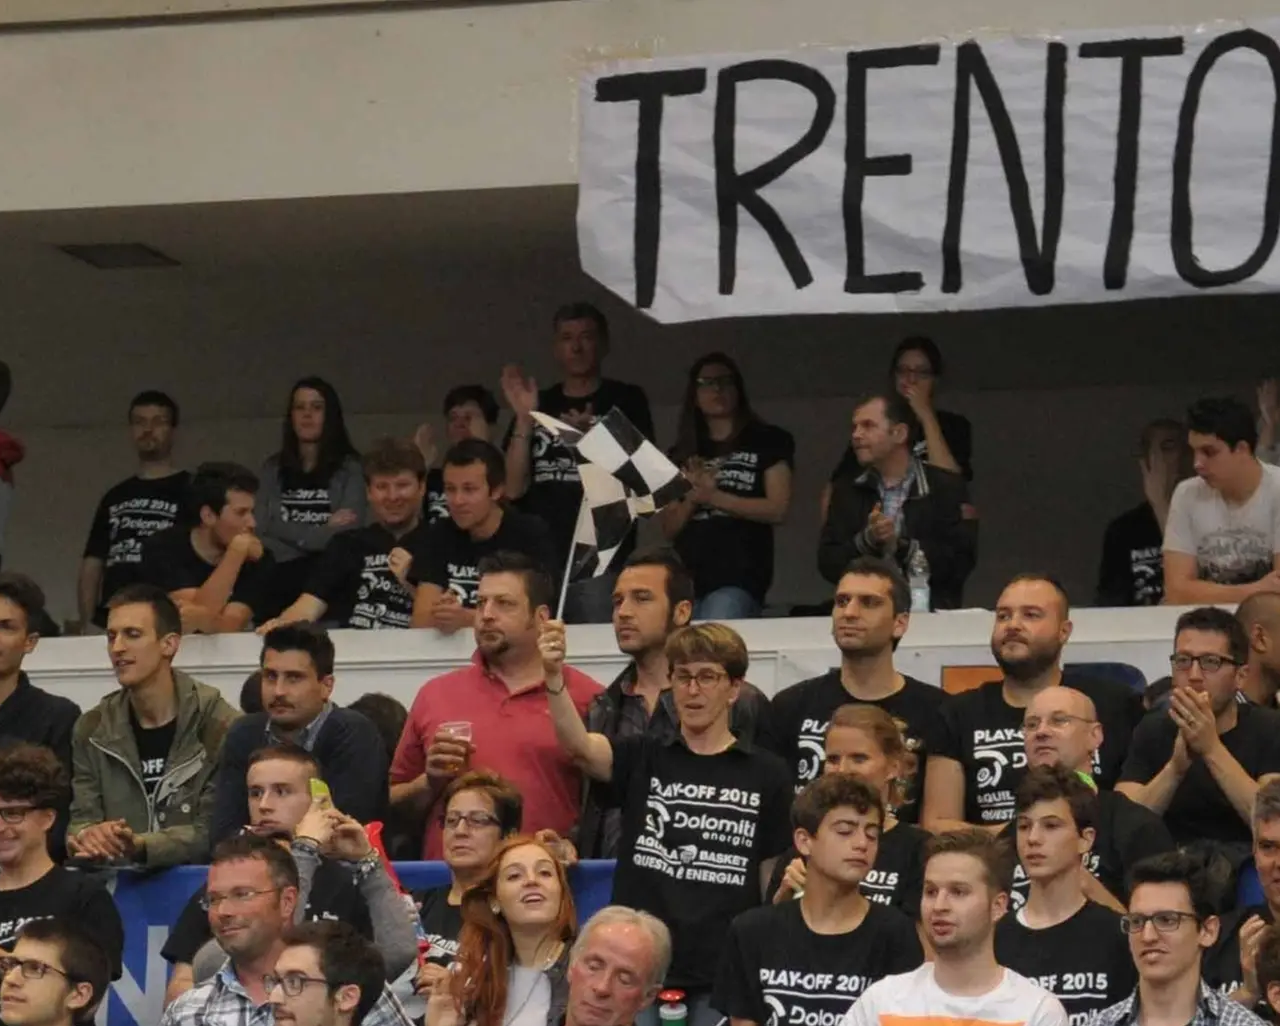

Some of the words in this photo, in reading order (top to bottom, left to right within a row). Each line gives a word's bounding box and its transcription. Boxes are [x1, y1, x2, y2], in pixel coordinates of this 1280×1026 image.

[447, 563, 481, 578] PLAY-
[650, 777, 717, 802] PLAY-OFF
[719, 786, 761, 808] 2015
[672, 810, 756, 839] Dolomiti
[702, 830, 754, 848] energia
[632, 852, 675, 877] QUESTA
[685, 867, 746, 885] ENERGIA!
[698, 850, 749, 869] BASKET
[866, 870, 899, 887] 015
[759, 968, 833, 989] PLAY-OFF
[1063, 971, 1109, 992] 2015
